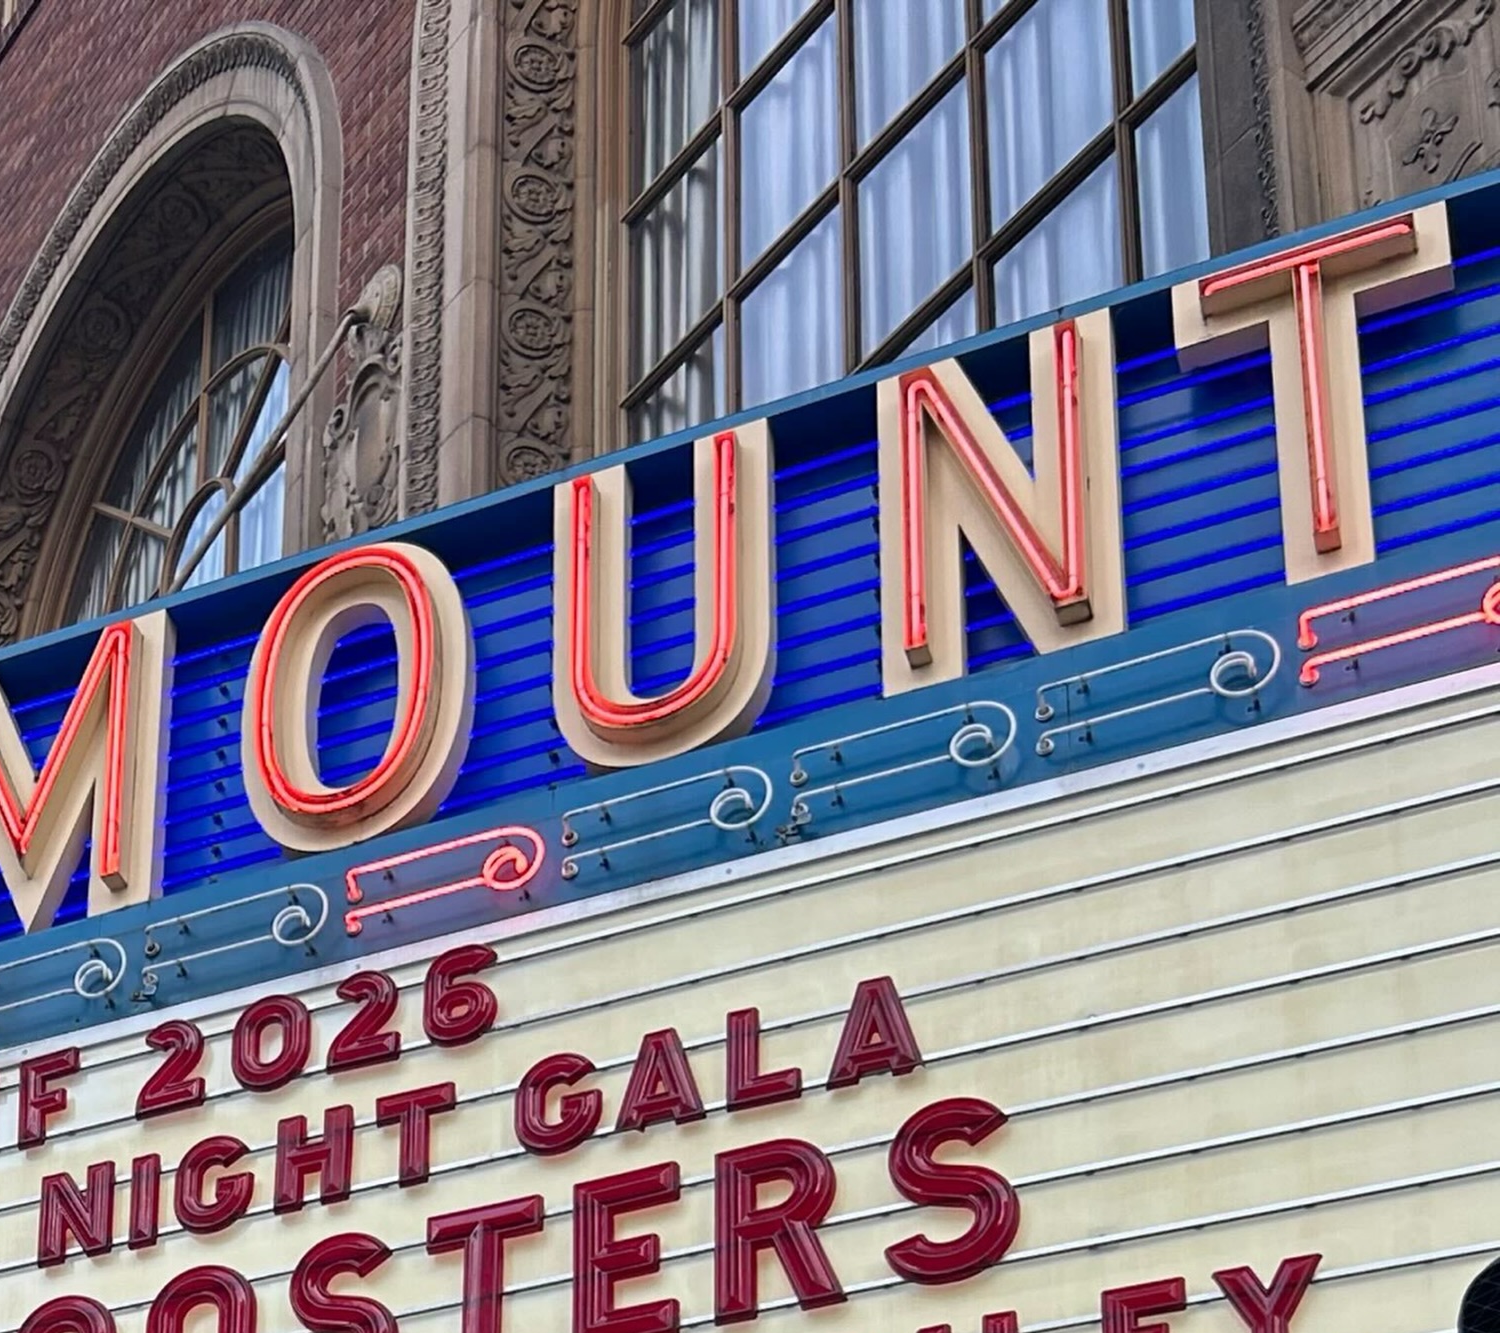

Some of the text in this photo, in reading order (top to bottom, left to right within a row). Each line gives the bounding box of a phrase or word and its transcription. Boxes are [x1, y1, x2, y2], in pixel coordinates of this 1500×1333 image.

[37, 1081, 458, 1268] NIGHT
[514, 975, 920, 1158] GALA
[136, 943, 499, 1120] 2026
